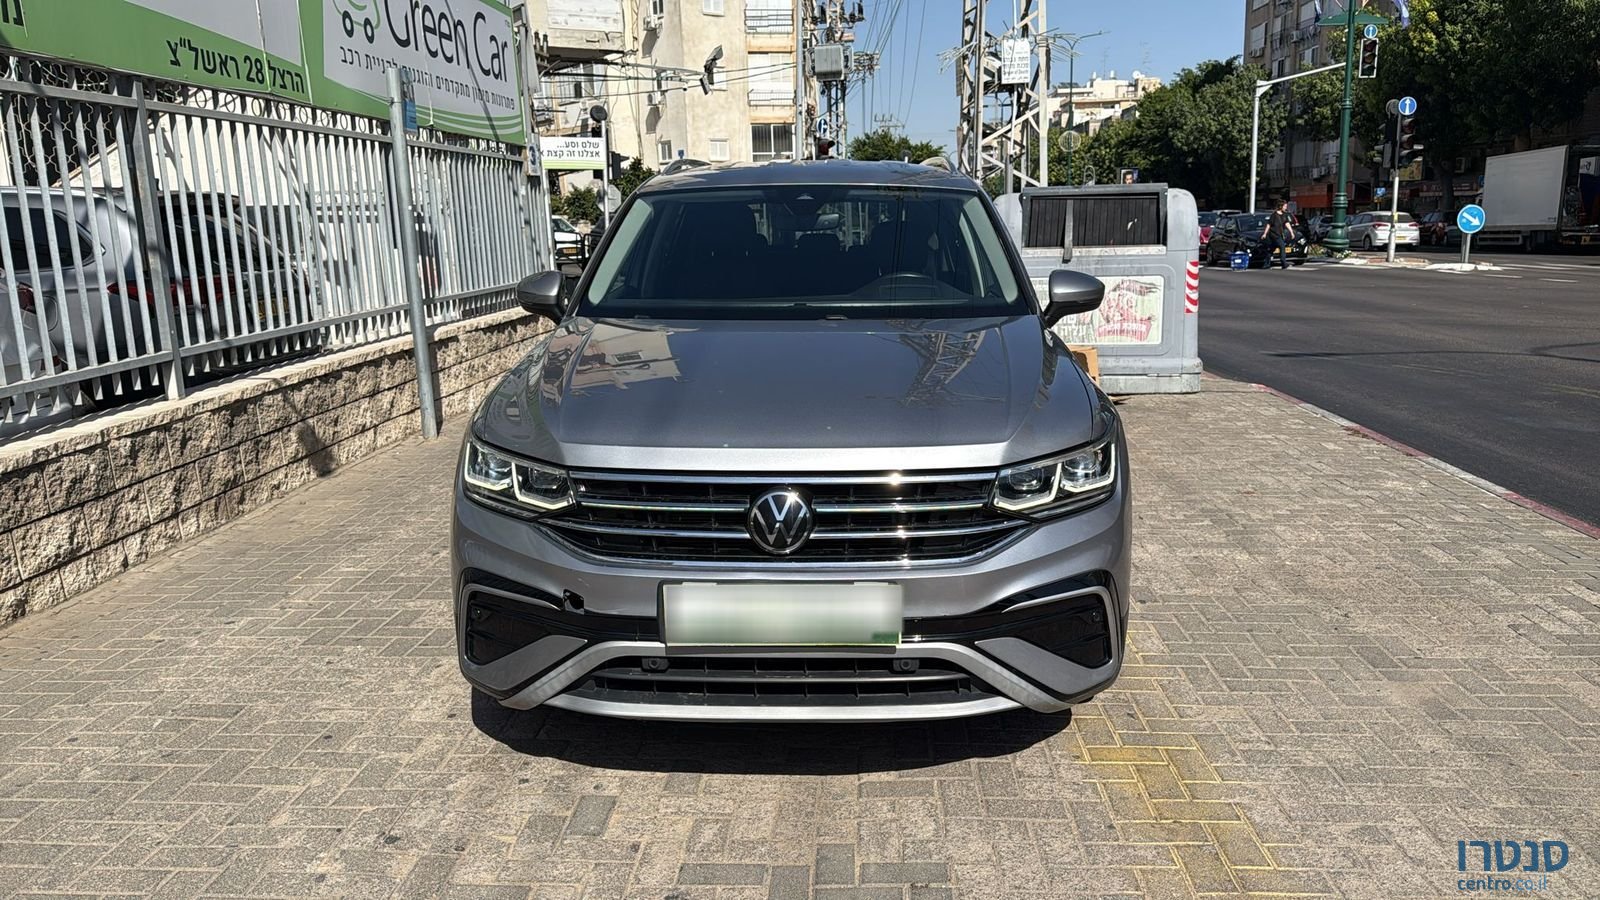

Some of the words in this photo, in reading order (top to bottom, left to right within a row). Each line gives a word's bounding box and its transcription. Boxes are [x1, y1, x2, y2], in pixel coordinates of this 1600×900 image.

[384, 0, 470, 70] Green
[473, 11, 508, 82] Car
[166, 37, 240, 79] ראשל"צ
[340, 46, 361, 67] רכב
[243, 55, 265, 84] 28
[267, 60, 305, 94] הרצל
[436, 75, 470, 98] מתקדמים
[546, 150, 564, 159] קצת
[566, 150, 576, 158] זה
[578, 149, 601, 158] אצלנו
[581, 140, 600, 149] שלם
